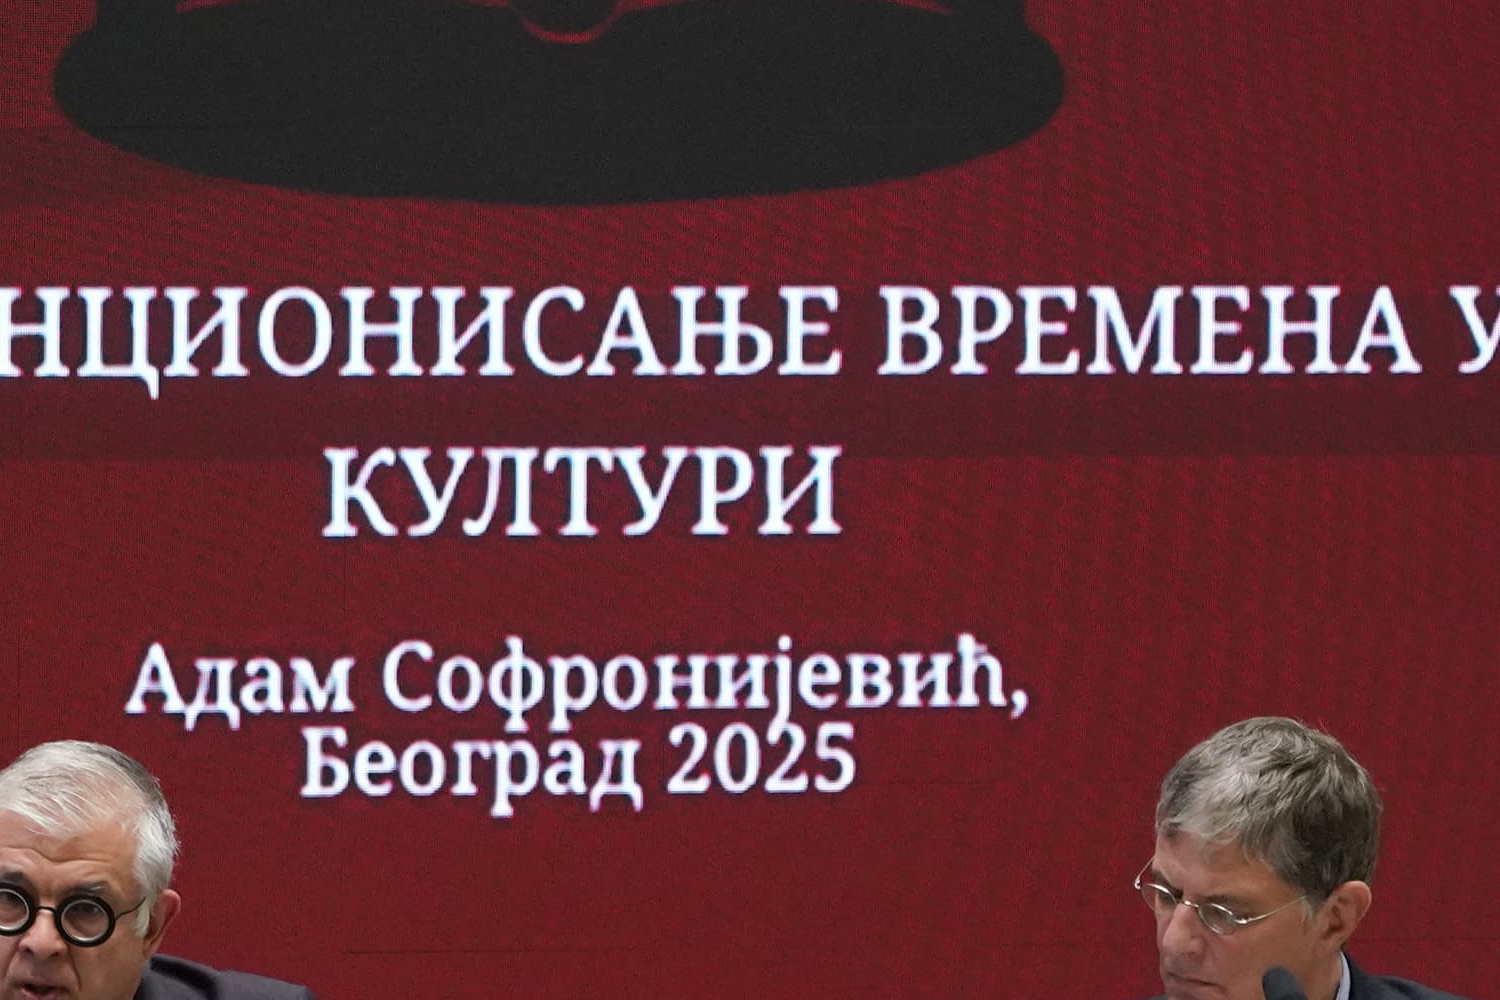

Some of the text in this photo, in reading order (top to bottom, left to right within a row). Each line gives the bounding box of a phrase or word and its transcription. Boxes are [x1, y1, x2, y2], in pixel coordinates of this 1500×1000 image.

[879, 286, 1422, 375] ВРЕМЕНА
[1450, 286, 1500, 373] У
[323, 447, 841, 536] КУЛТУРИ
[126, 634, 1030, 732] Адам Софронијевић,
[301, 723, 855, 816] Београд 2025
